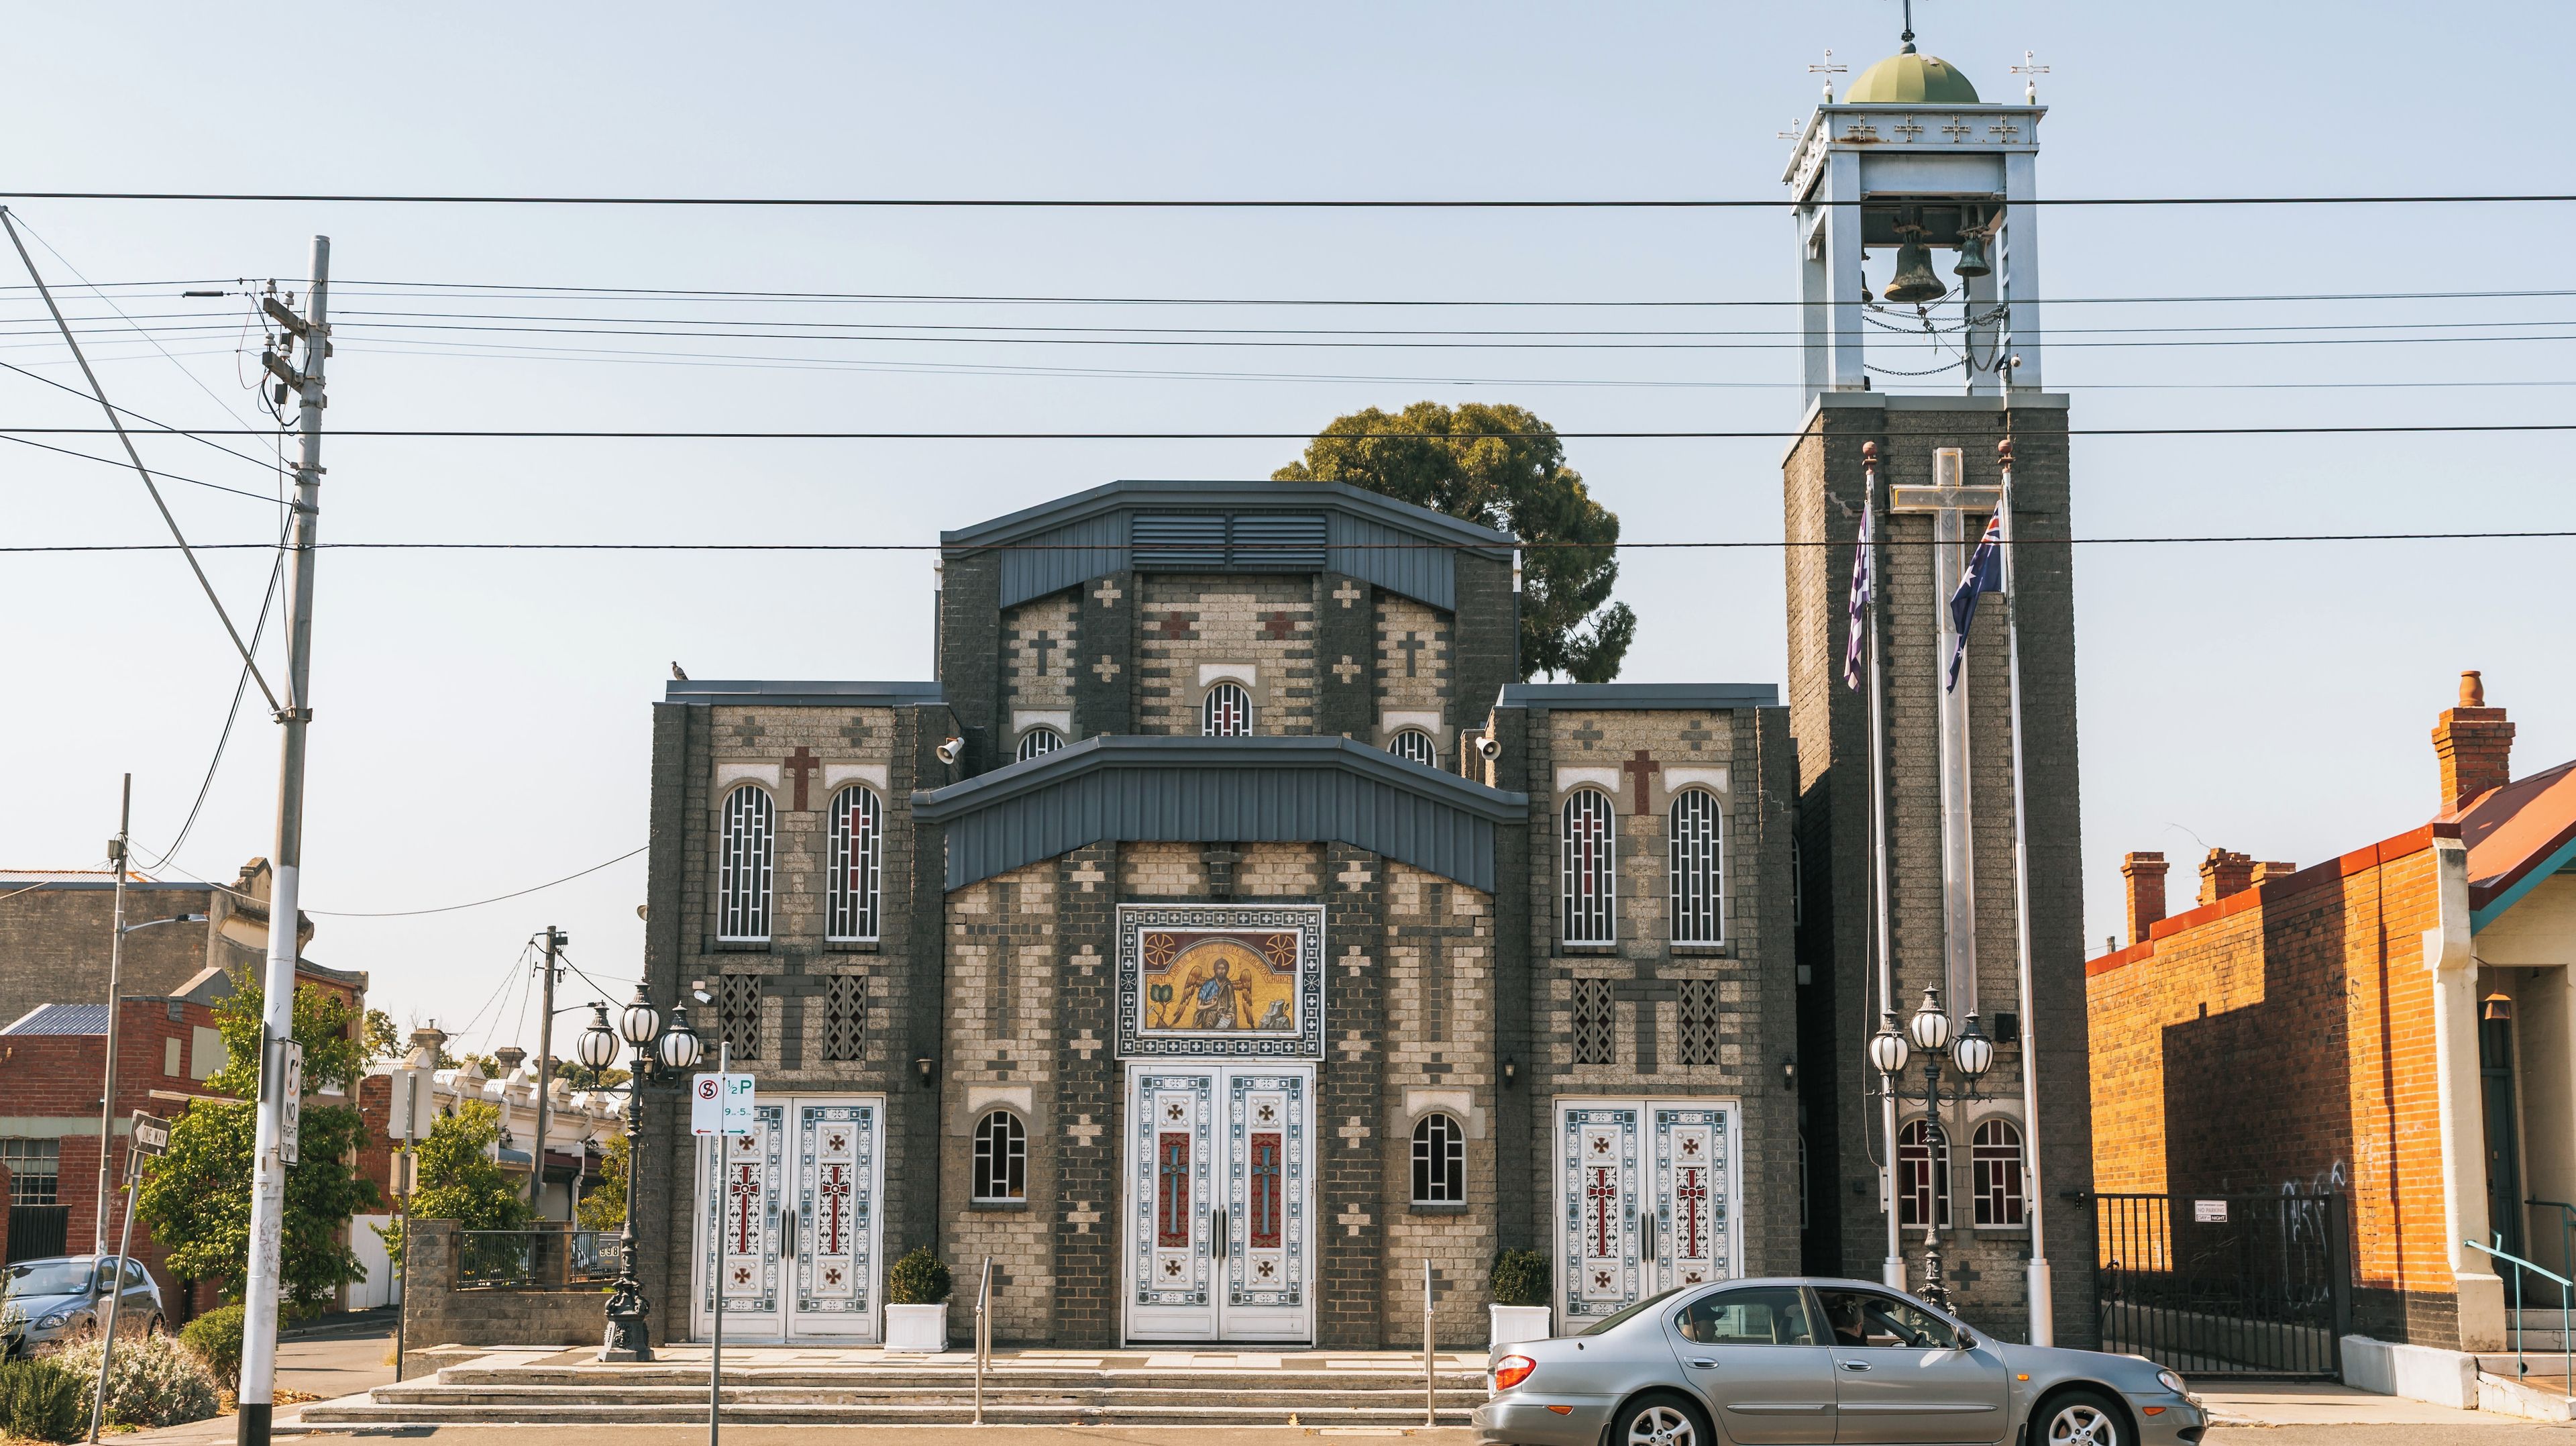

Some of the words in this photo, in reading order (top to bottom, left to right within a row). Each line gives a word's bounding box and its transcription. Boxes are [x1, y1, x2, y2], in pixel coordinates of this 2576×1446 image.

[1148, 975, 1166, 984] SAINT
[1169, 963, 1181, 980] JOHN
[1180, 956, 1190, 966] THE
[1189, 945, 1214, 960] BAPTIST
[1218, 945, 1240, 956] GREEK
[1242, 951, 1270, 978] ORTHODOX
[1267, 975, 1292, 984] CHURCH
[286, 1102, 296, 1121] NO
[142, 1127, 152, 1142] ONE
[154, 1130, 166, 1145] WAY
[282, 1125, 297, 1139] RIGHT
[282, 1143, 295, 1156] TURN
[600, 1247, 618, 1255] 998
